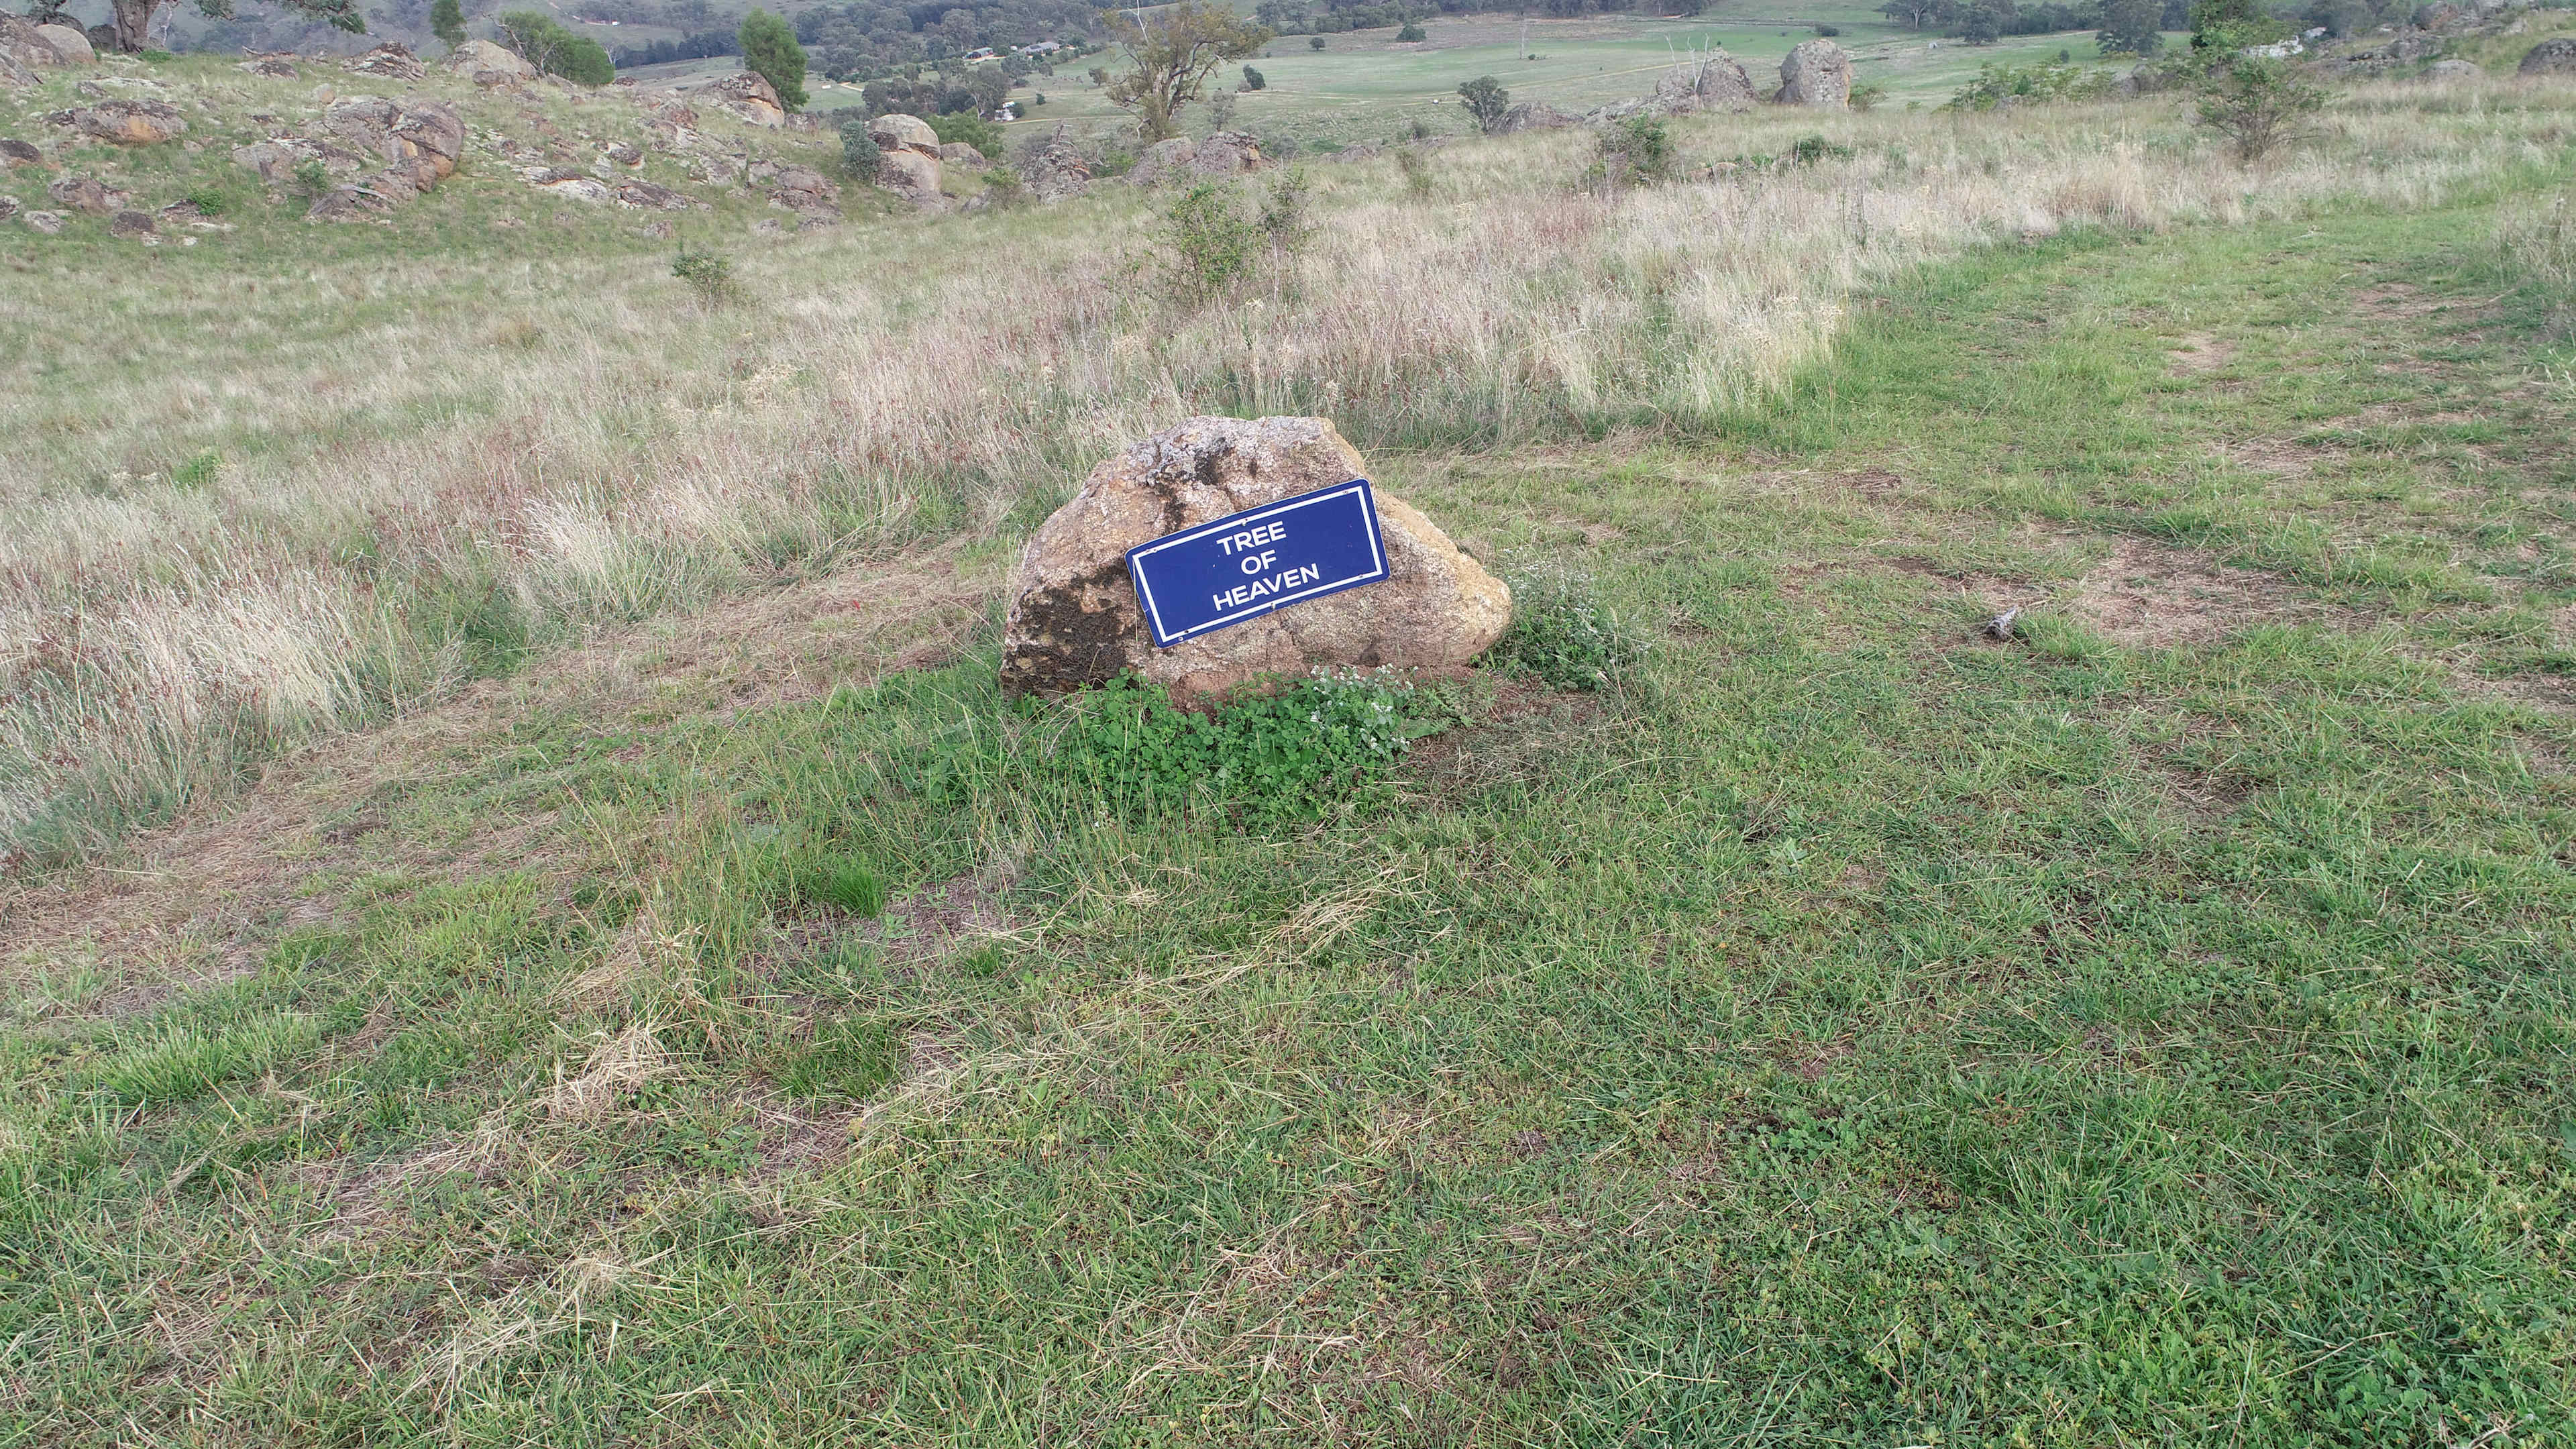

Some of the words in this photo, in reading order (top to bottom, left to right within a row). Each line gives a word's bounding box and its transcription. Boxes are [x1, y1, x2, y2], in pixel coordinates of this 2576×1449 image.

[1216, 521, 1287, 555] TREE
[1240, 550, 1277, 575] OF
[1213, 564, 1320, 611] HEAVEN
